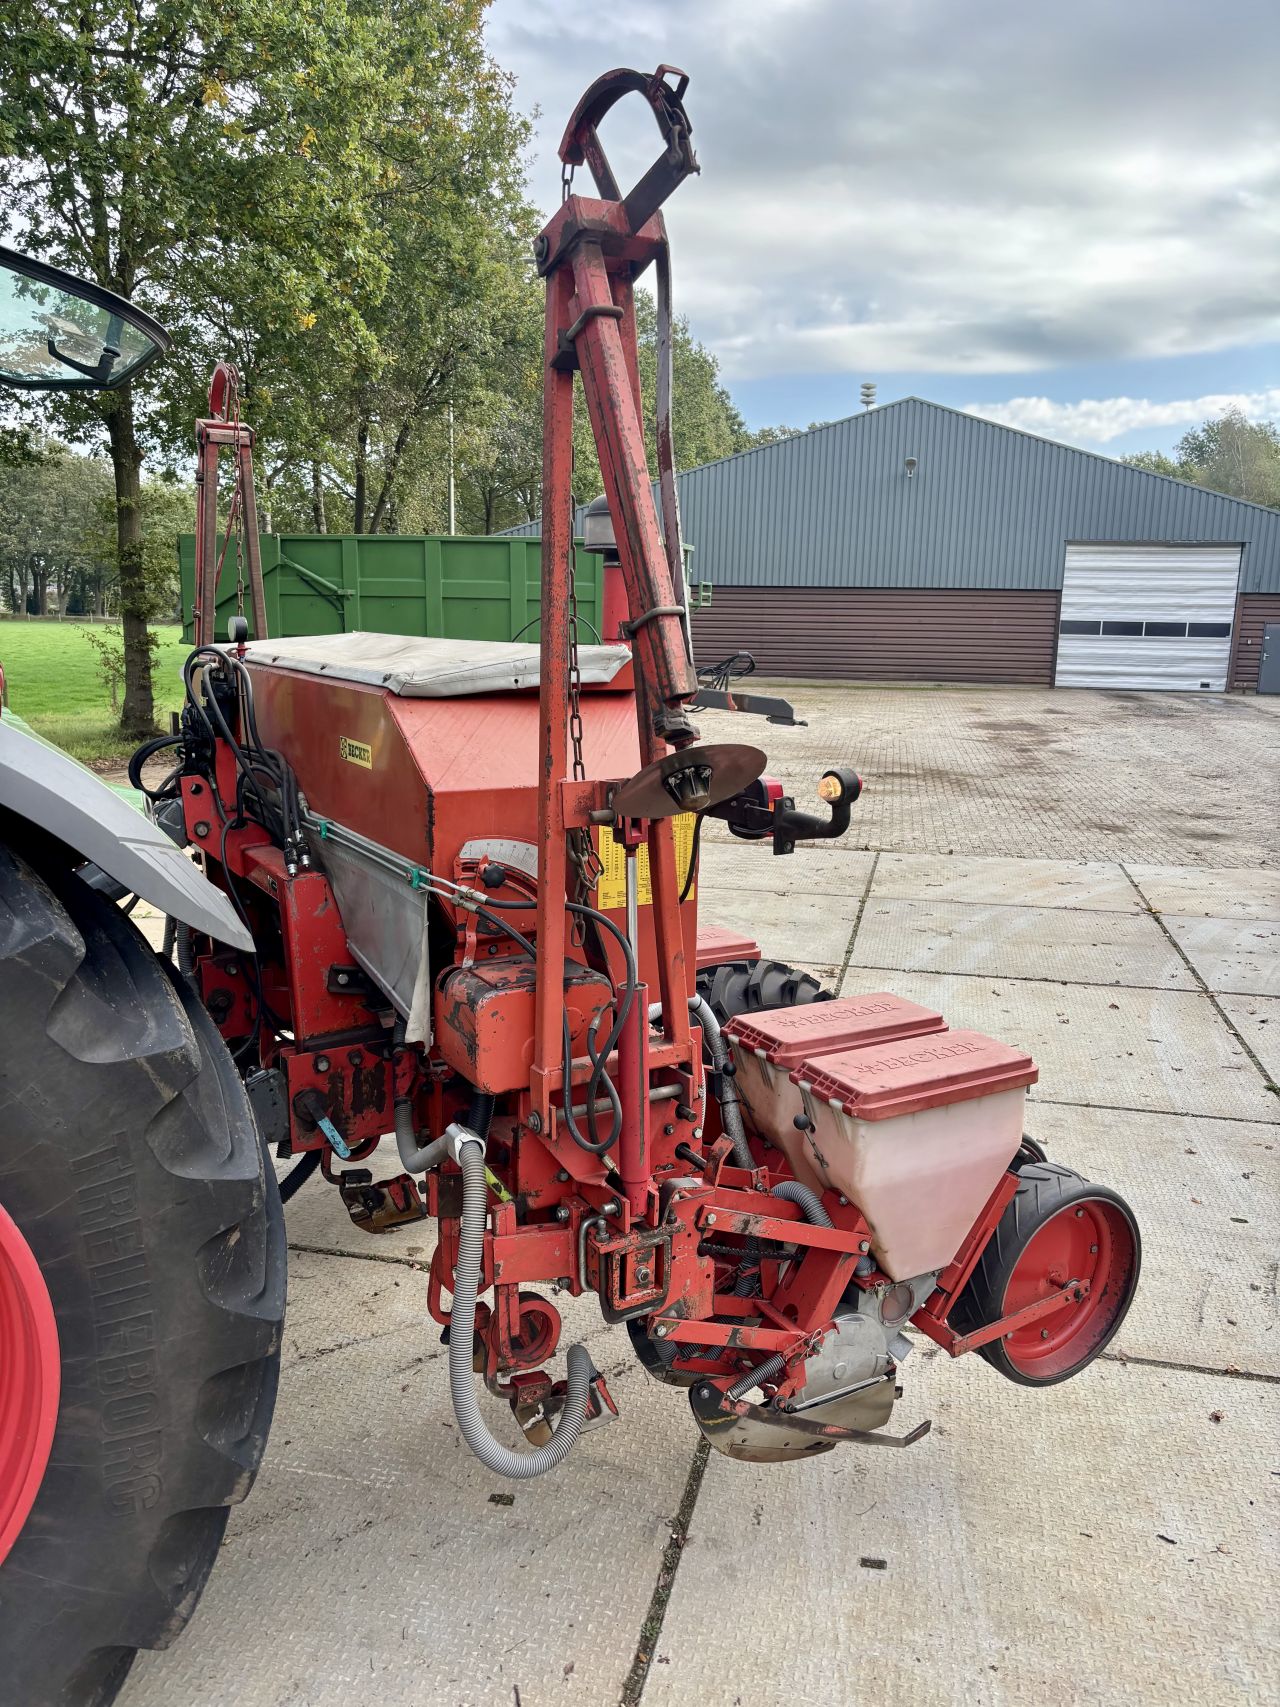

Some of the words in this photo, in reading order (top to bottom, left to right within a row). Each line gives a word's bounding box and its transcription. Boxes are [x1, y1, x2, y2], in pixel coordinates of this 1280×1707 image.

[347, 743, 371, 764] BECKER
[804, 1001, 900, 1025] BECKER
[882, 1041, 984, 1069] BECKER
[69, 1129, 162, 1517] TRELLEBORG
